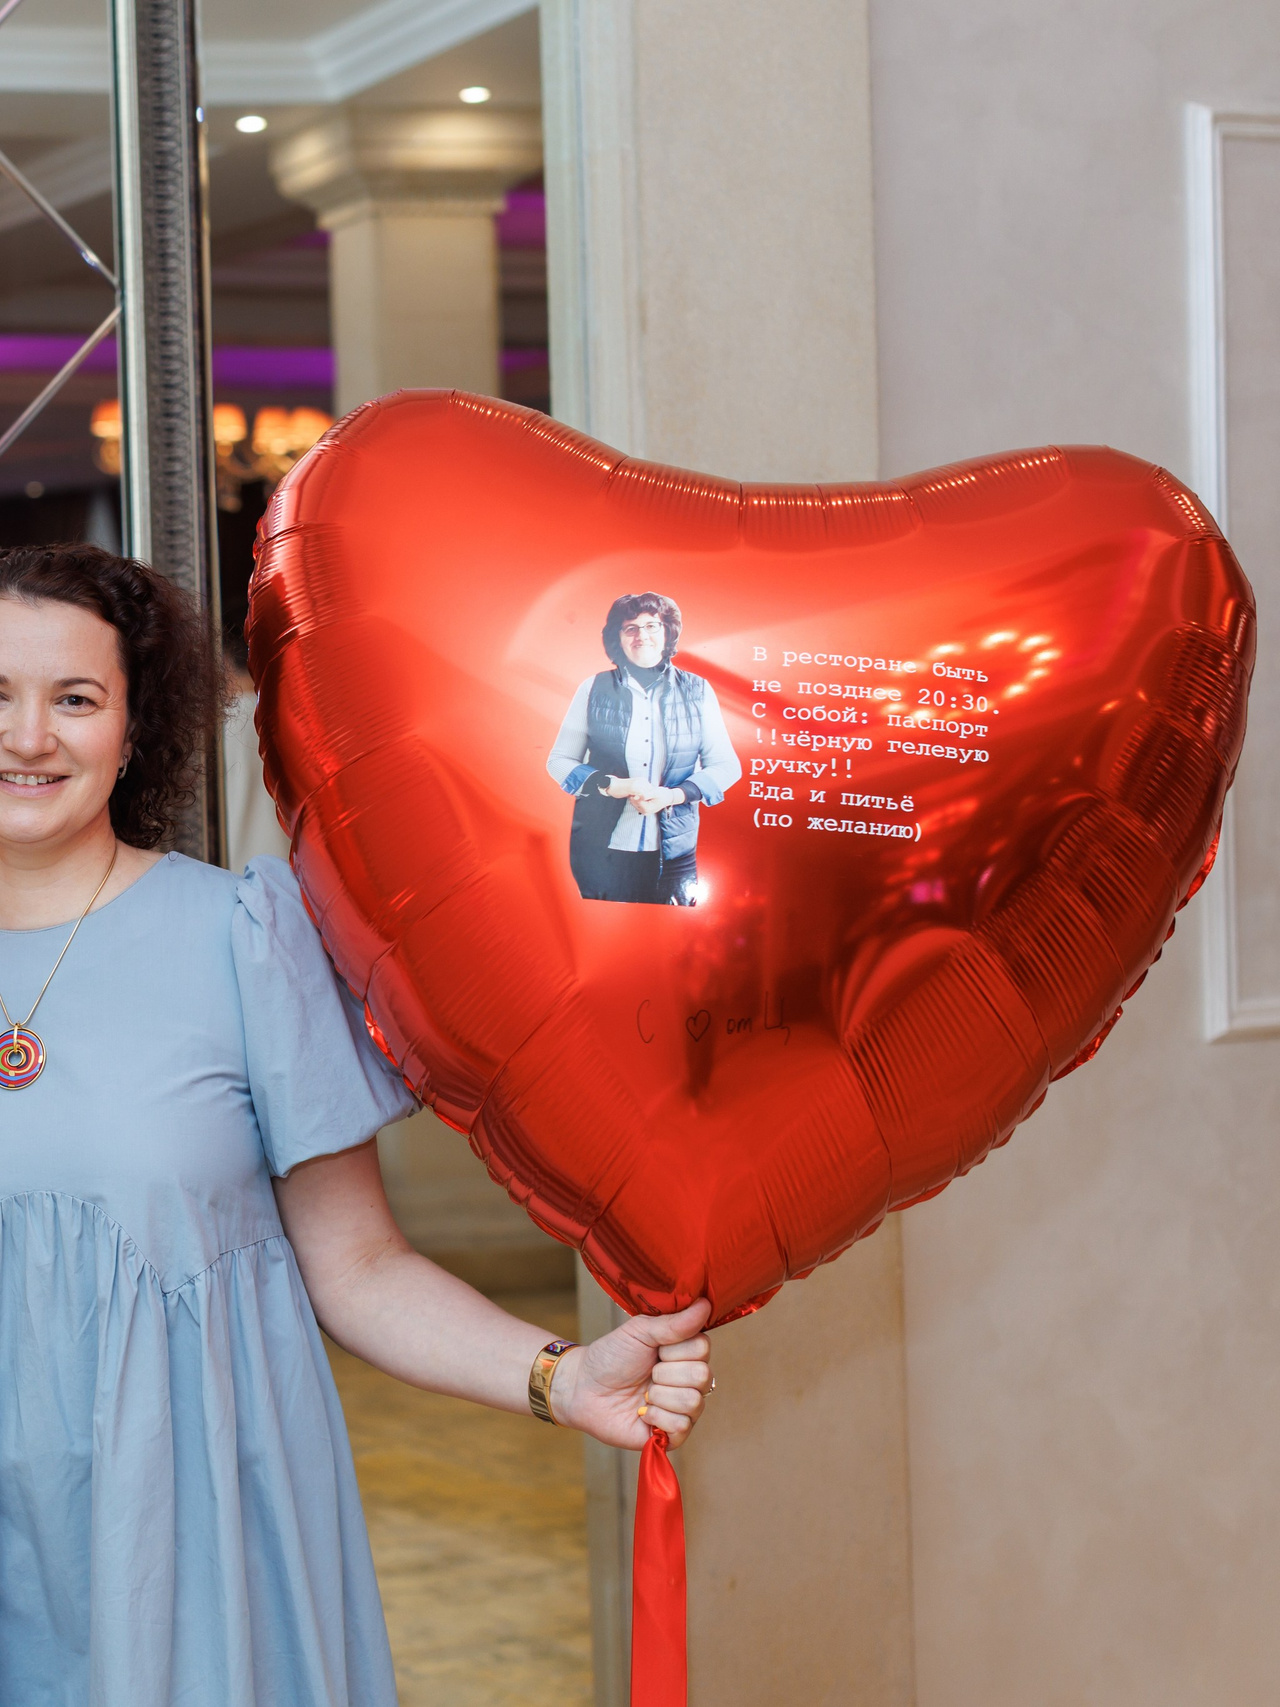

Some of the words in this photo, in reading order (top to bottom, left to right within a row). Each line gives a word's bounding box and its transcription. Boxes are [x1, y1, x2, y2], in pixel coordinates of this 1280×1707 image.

[753, 646, 768, 661] В
[782, 650, 918, 673] ресторане
[932, 662, 989, 683] быть
[752, 679, 782, 692] не
[797, 681, 902, 702] позднее
[918, 688, 1000, 715] 20:30.
[752, 702, 767, 719] С
[782, 705, 869, 725] собой:
[887, 713, 989, 739] паспорт
[756, 728, 873, 752] !!чёрную
[887, 739, 990, 764] гелевую
[749, 757, 852, 779] ручку!!
[749, 781, 795, 801] Еда
[809, 789, 826, 803] и
[840, 792, 915, 812] питьё
[753, 808, 793, 828] (по
[807, 816, 922, 843] желанию)
[726, 1017, 753, 1035] от
